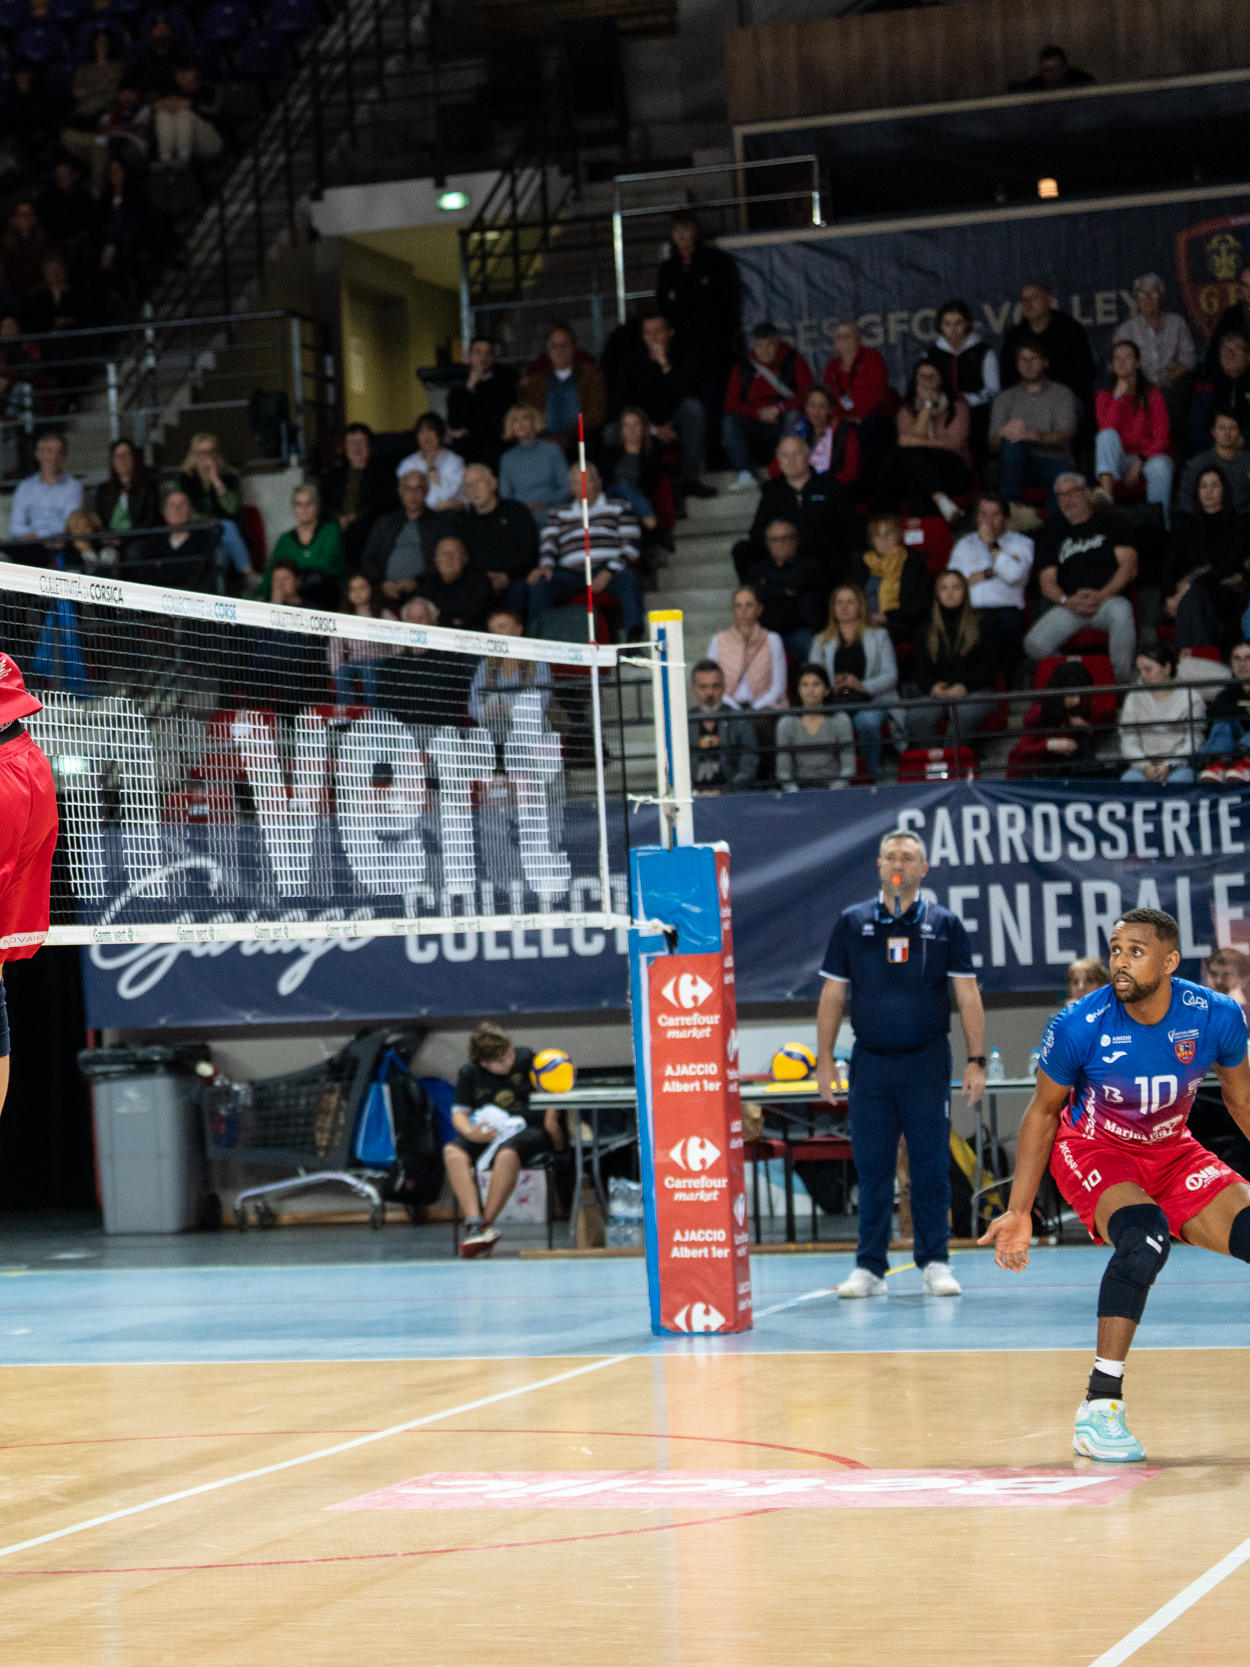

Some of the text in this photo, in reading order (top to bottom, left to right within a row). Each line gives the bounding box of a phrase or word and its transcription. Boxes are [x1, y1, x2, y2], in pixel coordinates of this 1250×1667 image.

[90, 583, 124, 605] CORSICA
[161, 594, 205, 617] COLLECTIVITÉ
[214, 602, 237, 621] CORSE
[310, 616, 337, 633] CORSICA
[93, 928, 128, 943] Gamm vert
[177, 926, 210, 941] Gamm vert
[254, 925, 273, 939] Gamm
[657, 1012, 721, 1027] Carrefour
[666, 1026, 711, 1040] market
[664, 1063, 718, 1077] AJACCIO
[662, 1080, 701, 1093] Albert
[703, 1079, 722, 1092] 1er
[1134, 1074, 1178, 1115] 10
[663, 1175, 728, 1190] Carrefour
[1082, 1168, 1103, 1192] 10
[673, 1189, 720, 1203] market
[673, 1229, 726, 1243] AJACCIO
[670, 1246, 709, 1259] Albert
[711, 1245, 730, 1259] 1er
